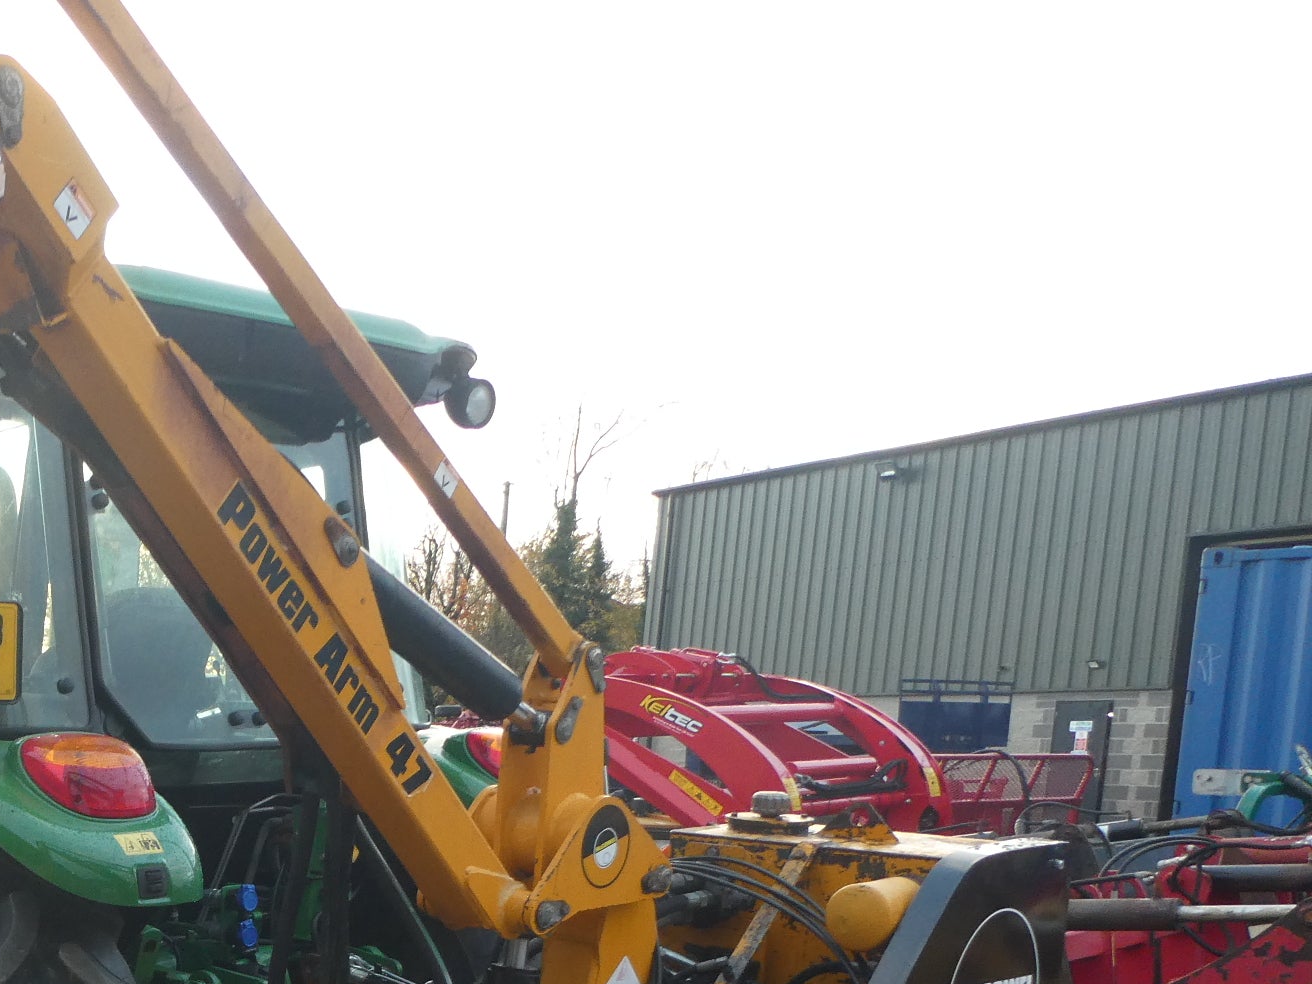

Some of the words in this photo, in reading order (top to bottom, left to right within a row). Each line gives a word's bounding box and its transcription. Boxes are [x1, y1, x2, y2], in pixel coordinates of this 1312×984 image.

[217, 482, 319, 632] Power
[314, 632, 379, 735] Arm
[386, 733, 433, 794] 47
